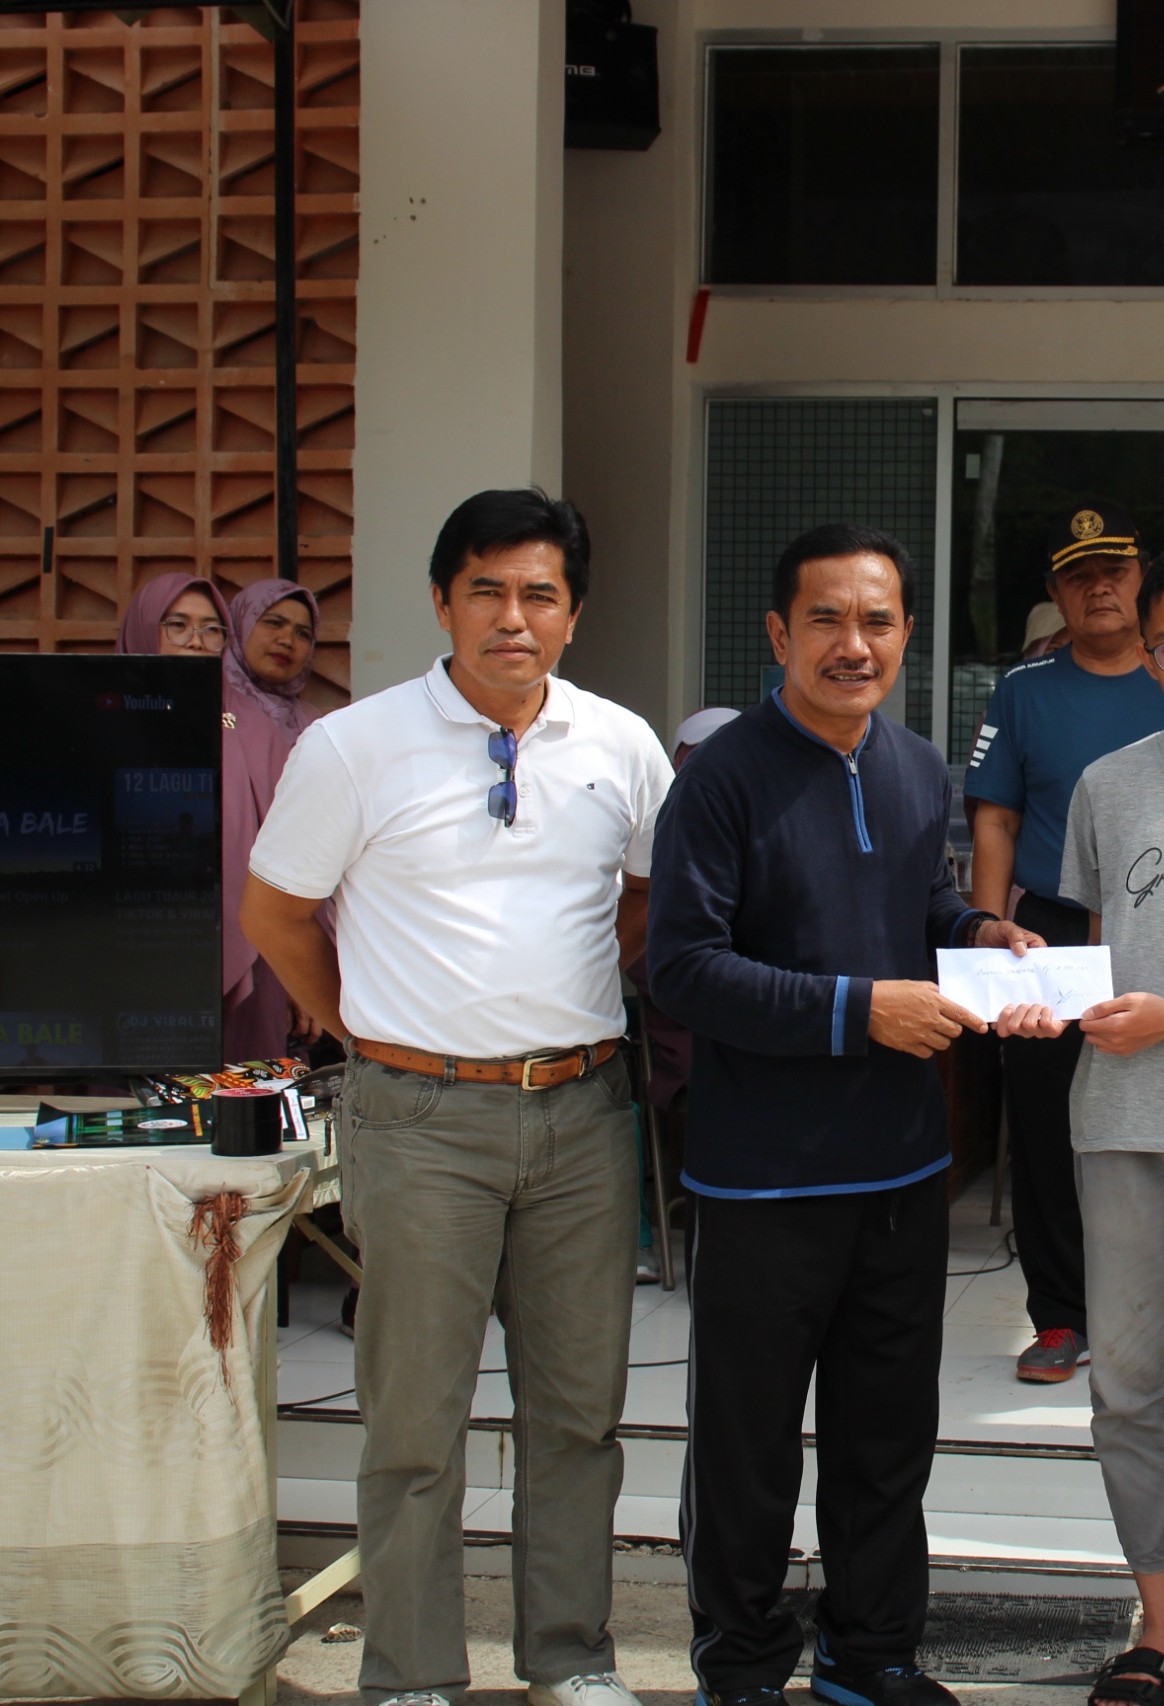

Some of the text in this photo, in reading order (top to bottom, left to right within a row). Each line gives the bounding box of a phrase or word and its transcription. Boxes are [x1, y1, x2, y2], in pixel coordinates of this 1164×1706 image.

[123, 694, 174, 711] YouTube
[124, 773, 145, 793] 12
[149, 773, 193, 793] LAGU
[20, 811, 89, 837] BALE
[17, 1022, 83, 1046] BALE
